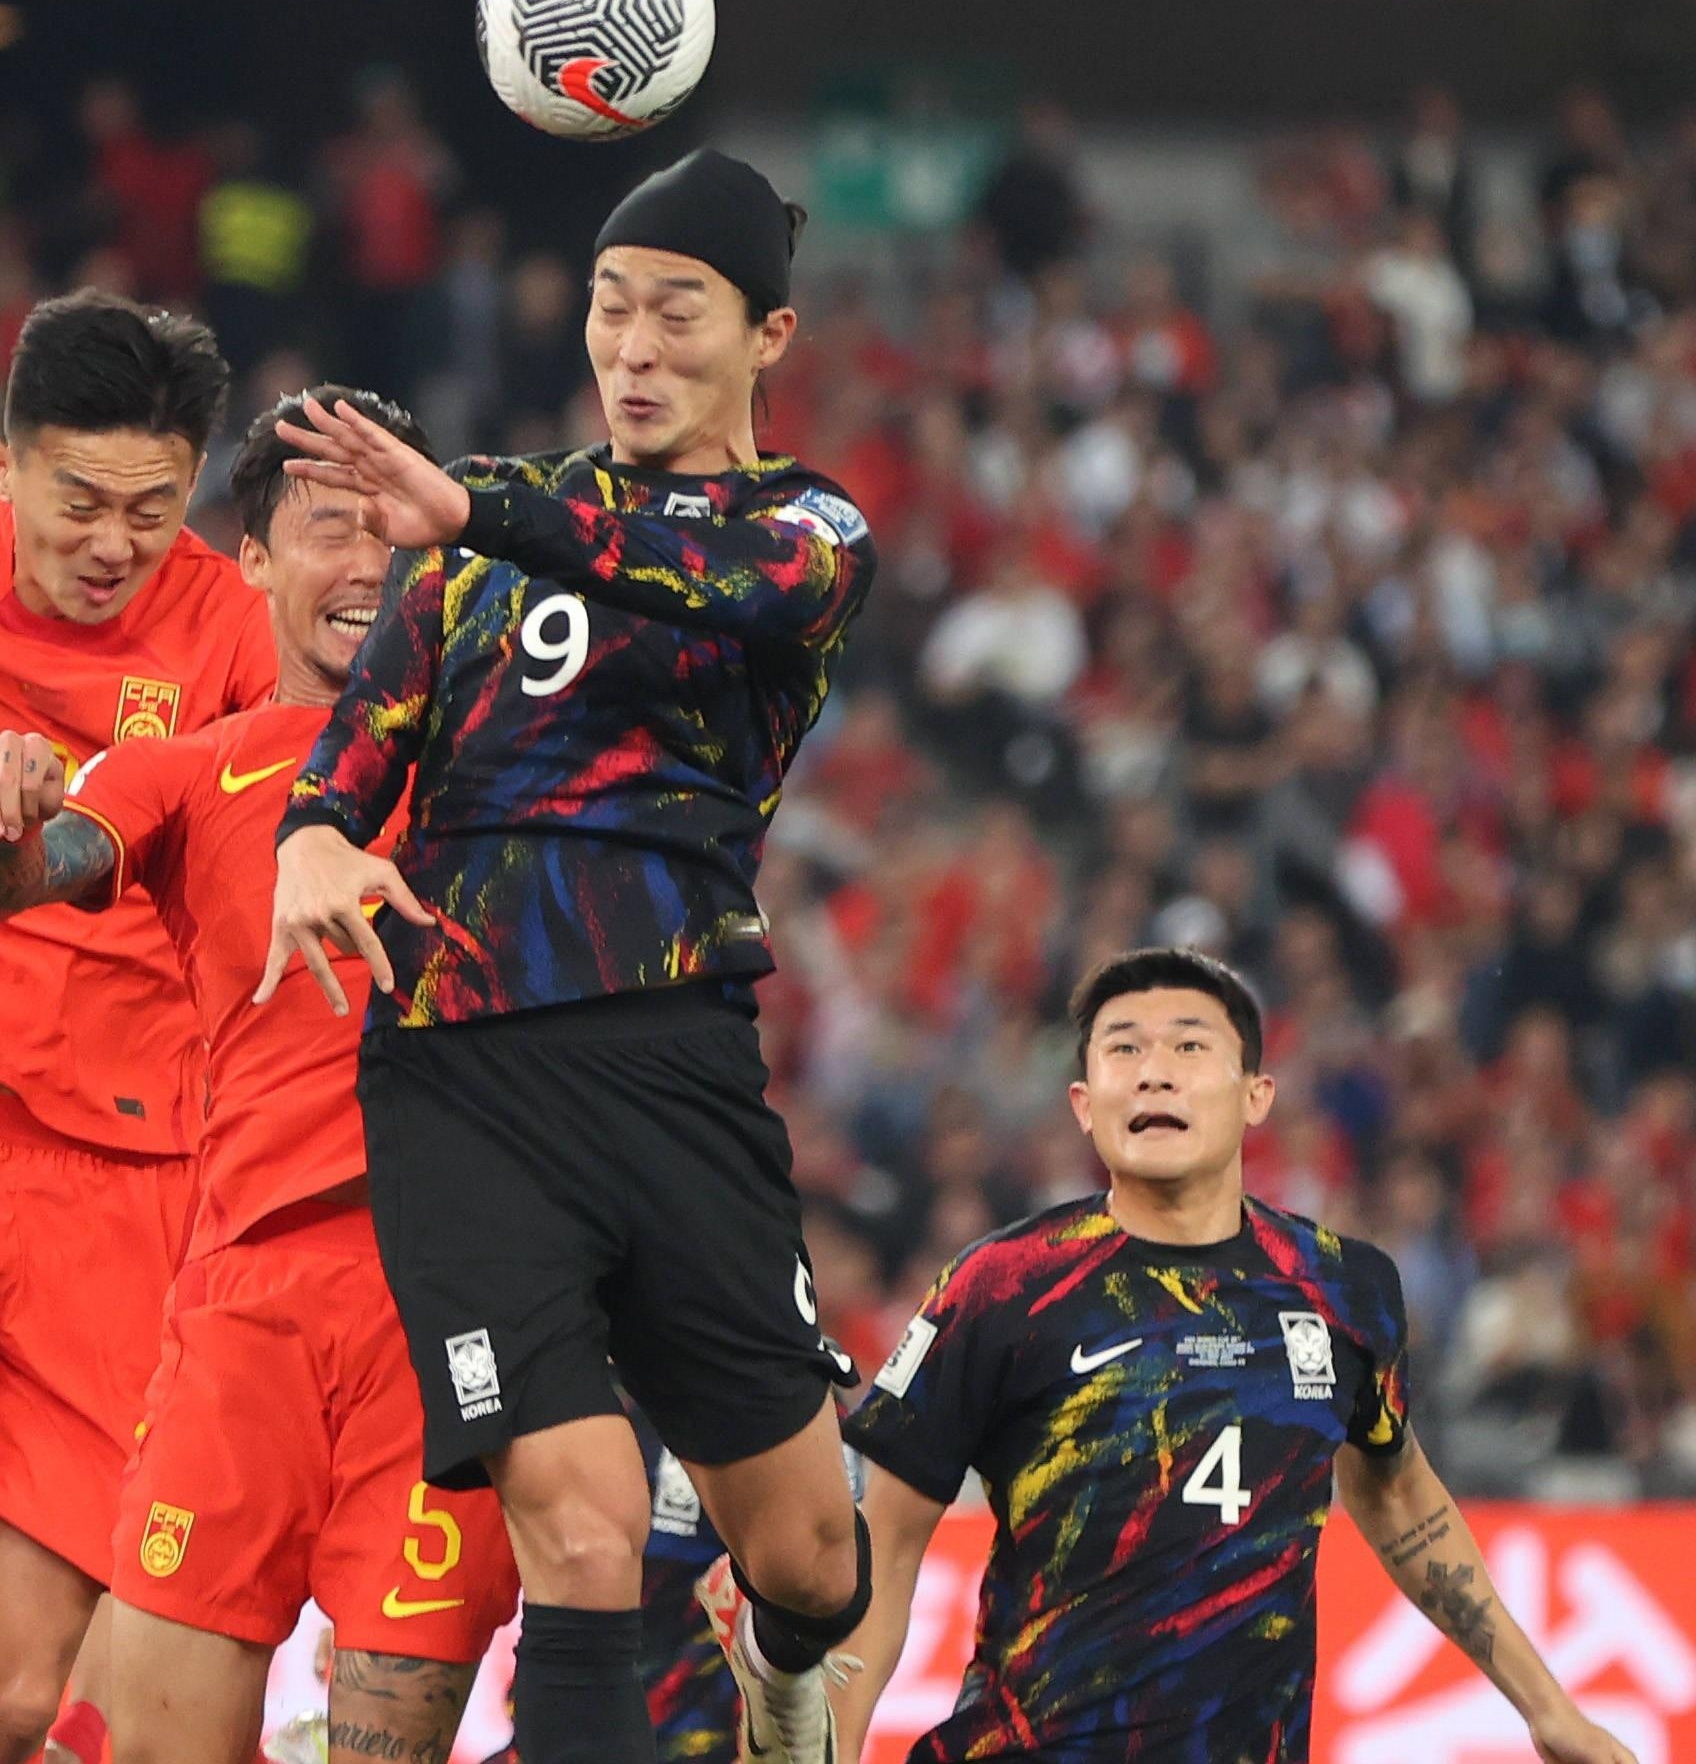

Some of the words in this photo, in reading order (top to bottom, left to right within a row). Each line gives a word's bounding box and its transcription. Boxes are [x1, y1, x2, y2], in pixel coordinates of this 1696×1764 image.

[520, 593, 590, 697] 9
[125, 682, 176, 706] CFA
[460, 1397, 503, 1422] KOREA
[1294, 1384, 1333, 1401] KOREA
[1182, 1425, 1252, 1525] 4
[404, 1481, 462, 1581] 5
